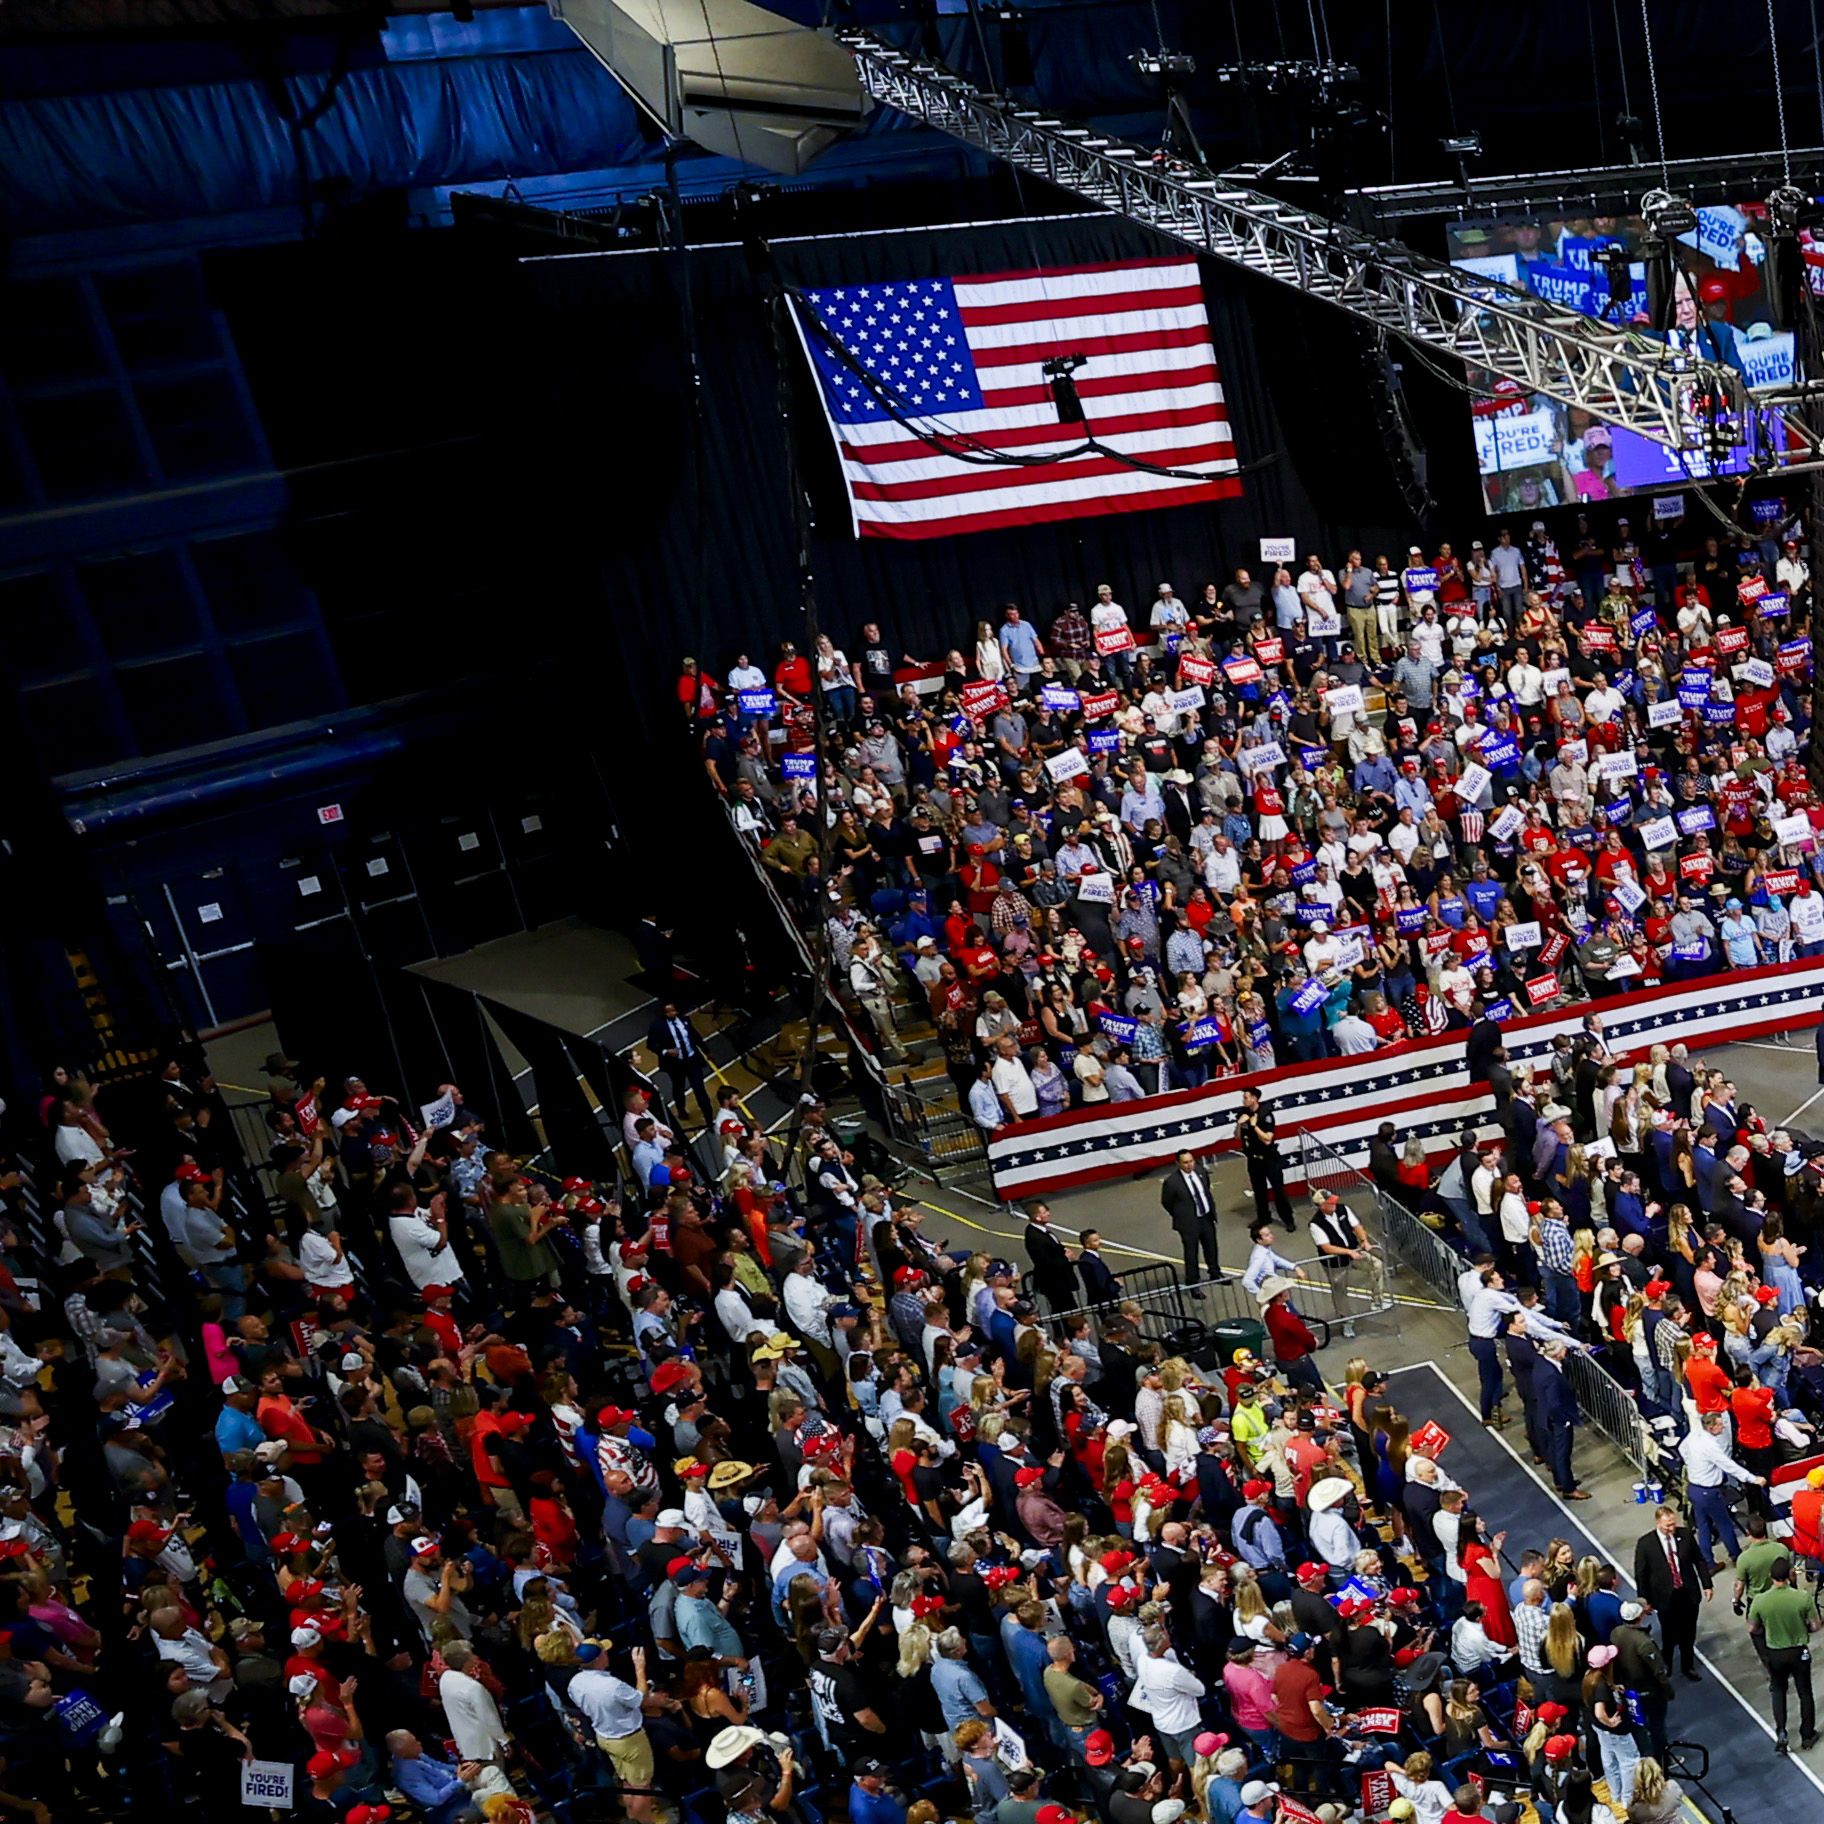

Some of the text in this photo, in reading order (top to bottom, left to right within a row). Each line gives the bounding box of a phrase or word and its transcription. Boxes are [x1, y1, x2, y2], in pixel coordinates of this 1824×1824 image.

[1696, 209, 1744, 238] OU'RE
[1697, 224, 1739, 250] RED!
[1532, 272, 1591, 294] TRUMP
[1484, 425, 1541, 443] YOU'RE
[1482, 434, 1551, 459] FRED!
[1652, 710, 1679, 721] FIRED!
[1647, 829, 1671, 844] FIRED!
[1082, 888, 1111, 896] FIRED!
[1510, 935, 1537, 944] FIRED!
[249, 1771, 286, 1784] YOU'RE
[246, 1782, 290, 1798] FIRED!
